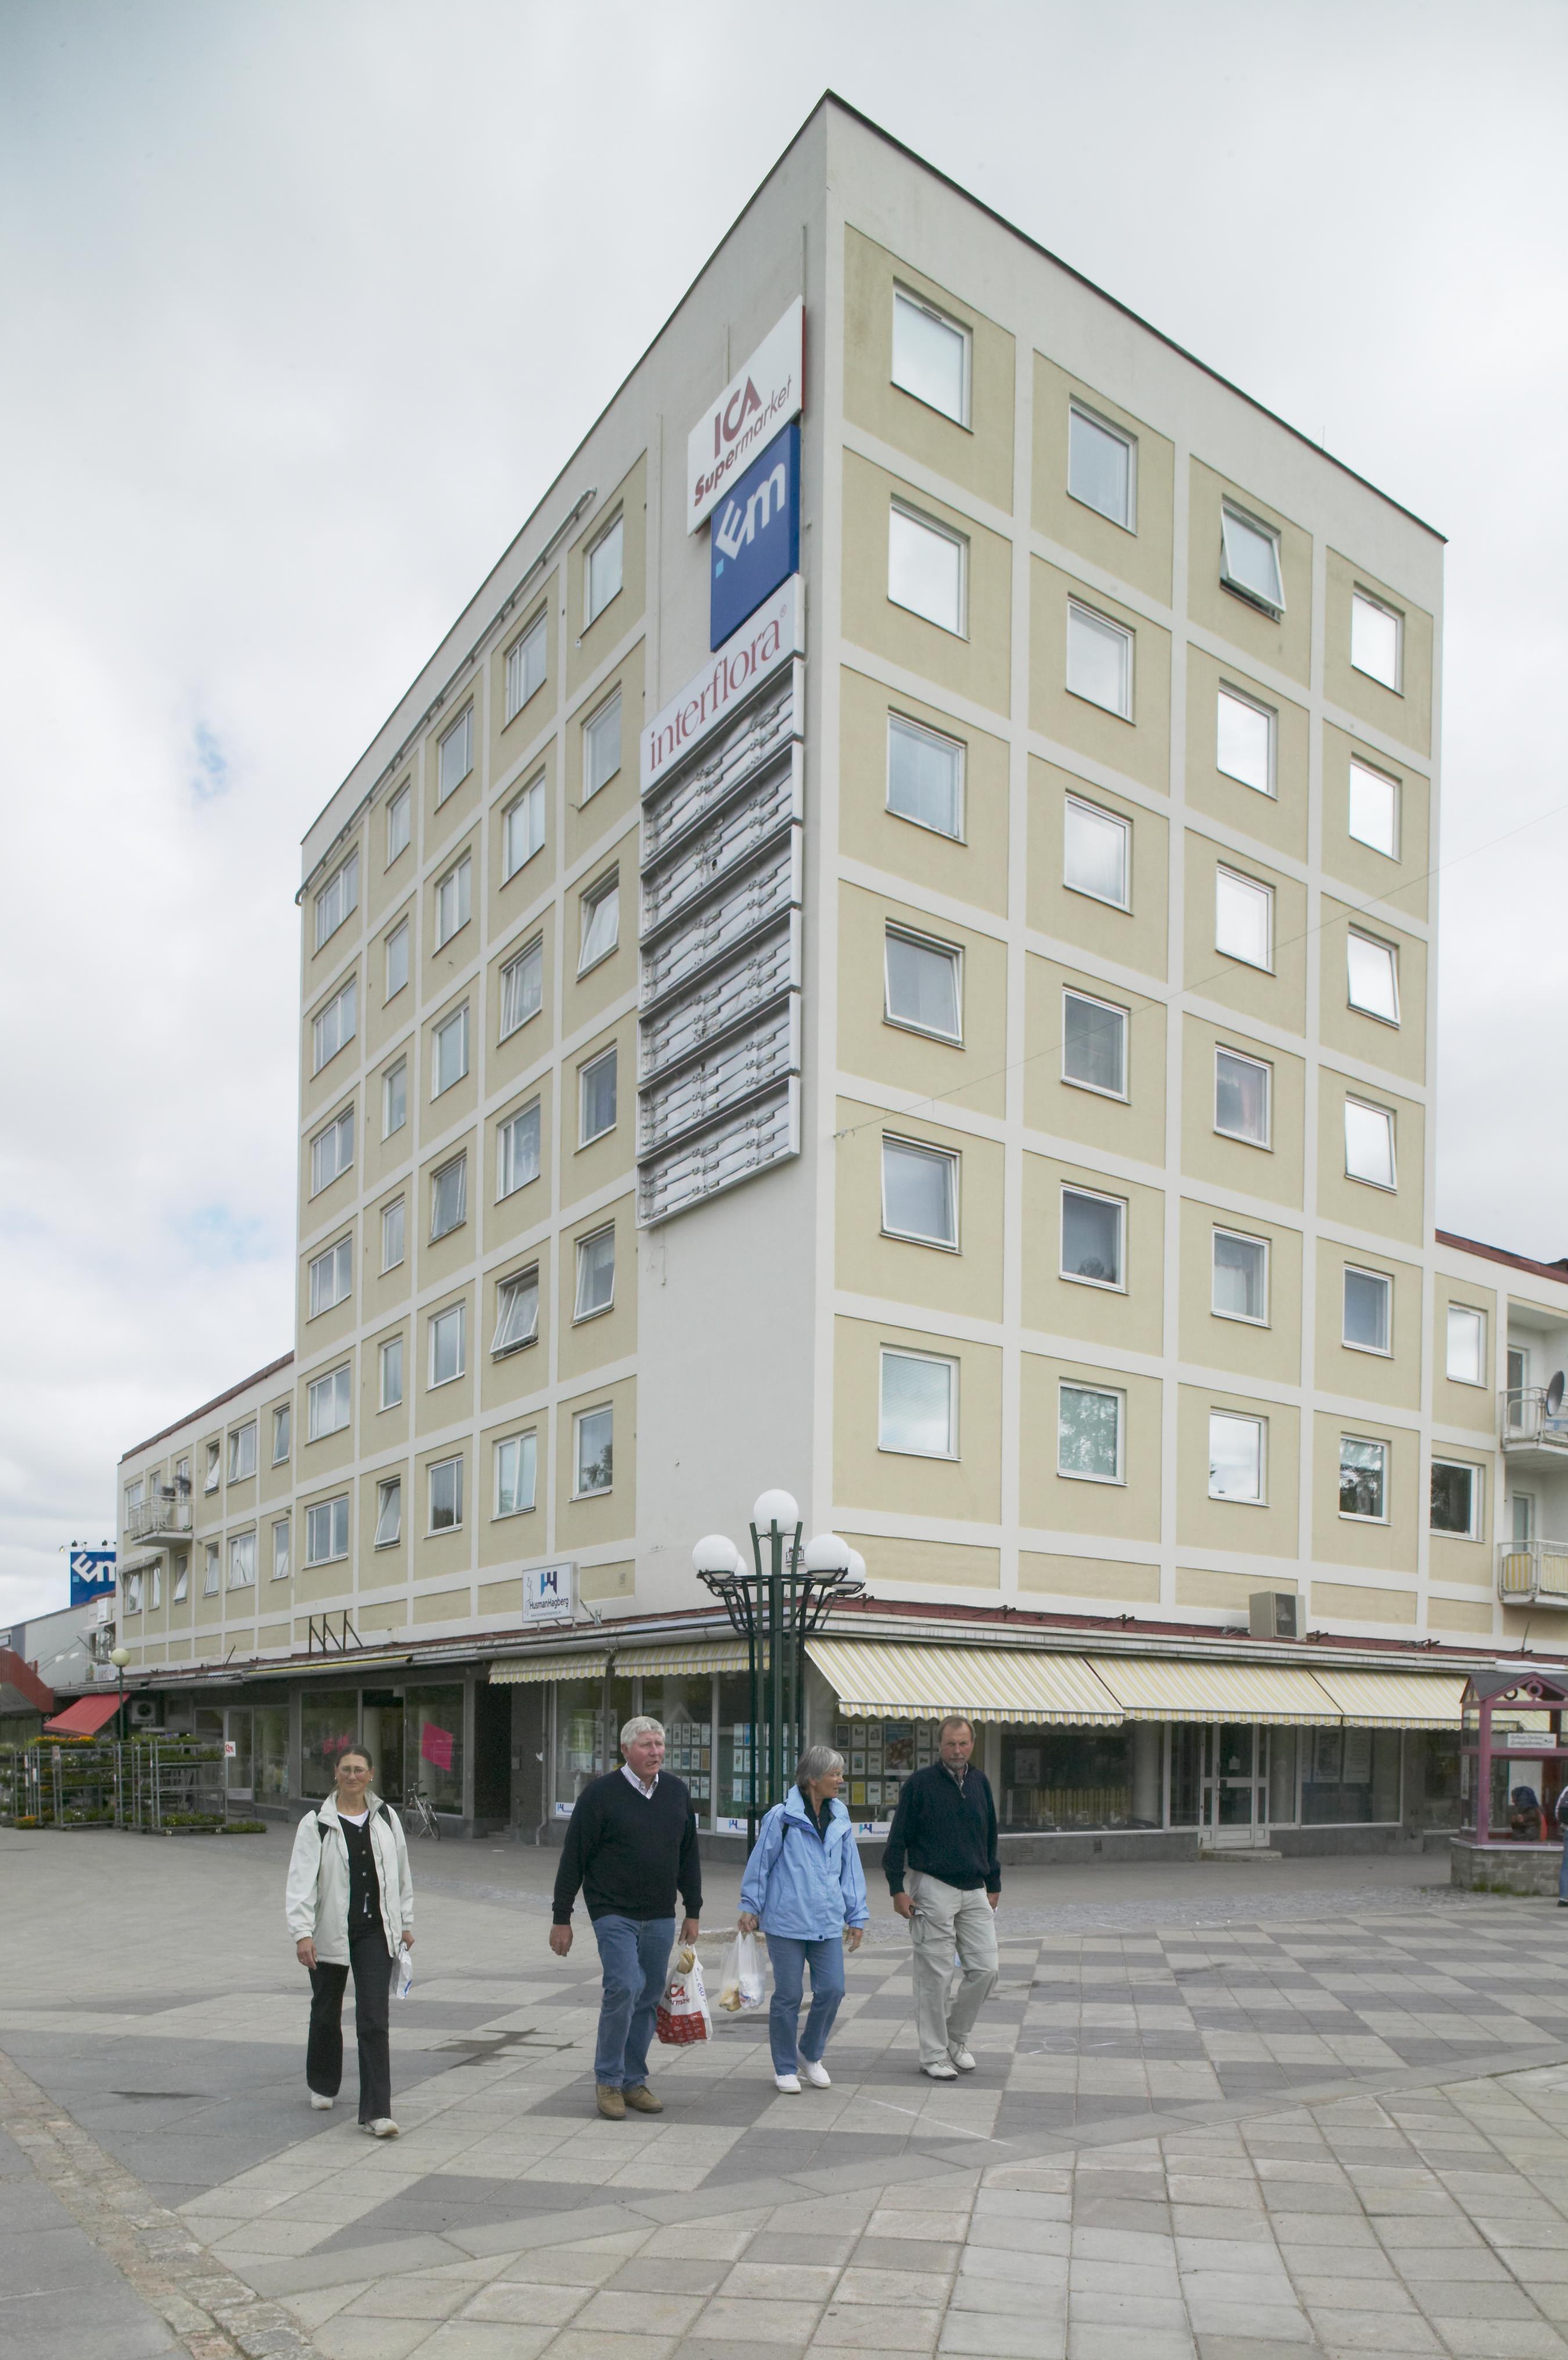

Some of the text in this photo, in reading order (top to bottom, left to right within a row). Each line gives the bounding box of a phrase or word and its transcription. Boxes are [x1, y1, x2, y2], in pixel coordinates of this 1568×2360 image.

[694, 375, 792, 507] Supermarket
[714, 375, 762, 459] ICA
[715, 463, 786, 560] Em
[650, 620, 781, 772] interflora
[530, 1598, 569, 1610] HusmanHagberg
